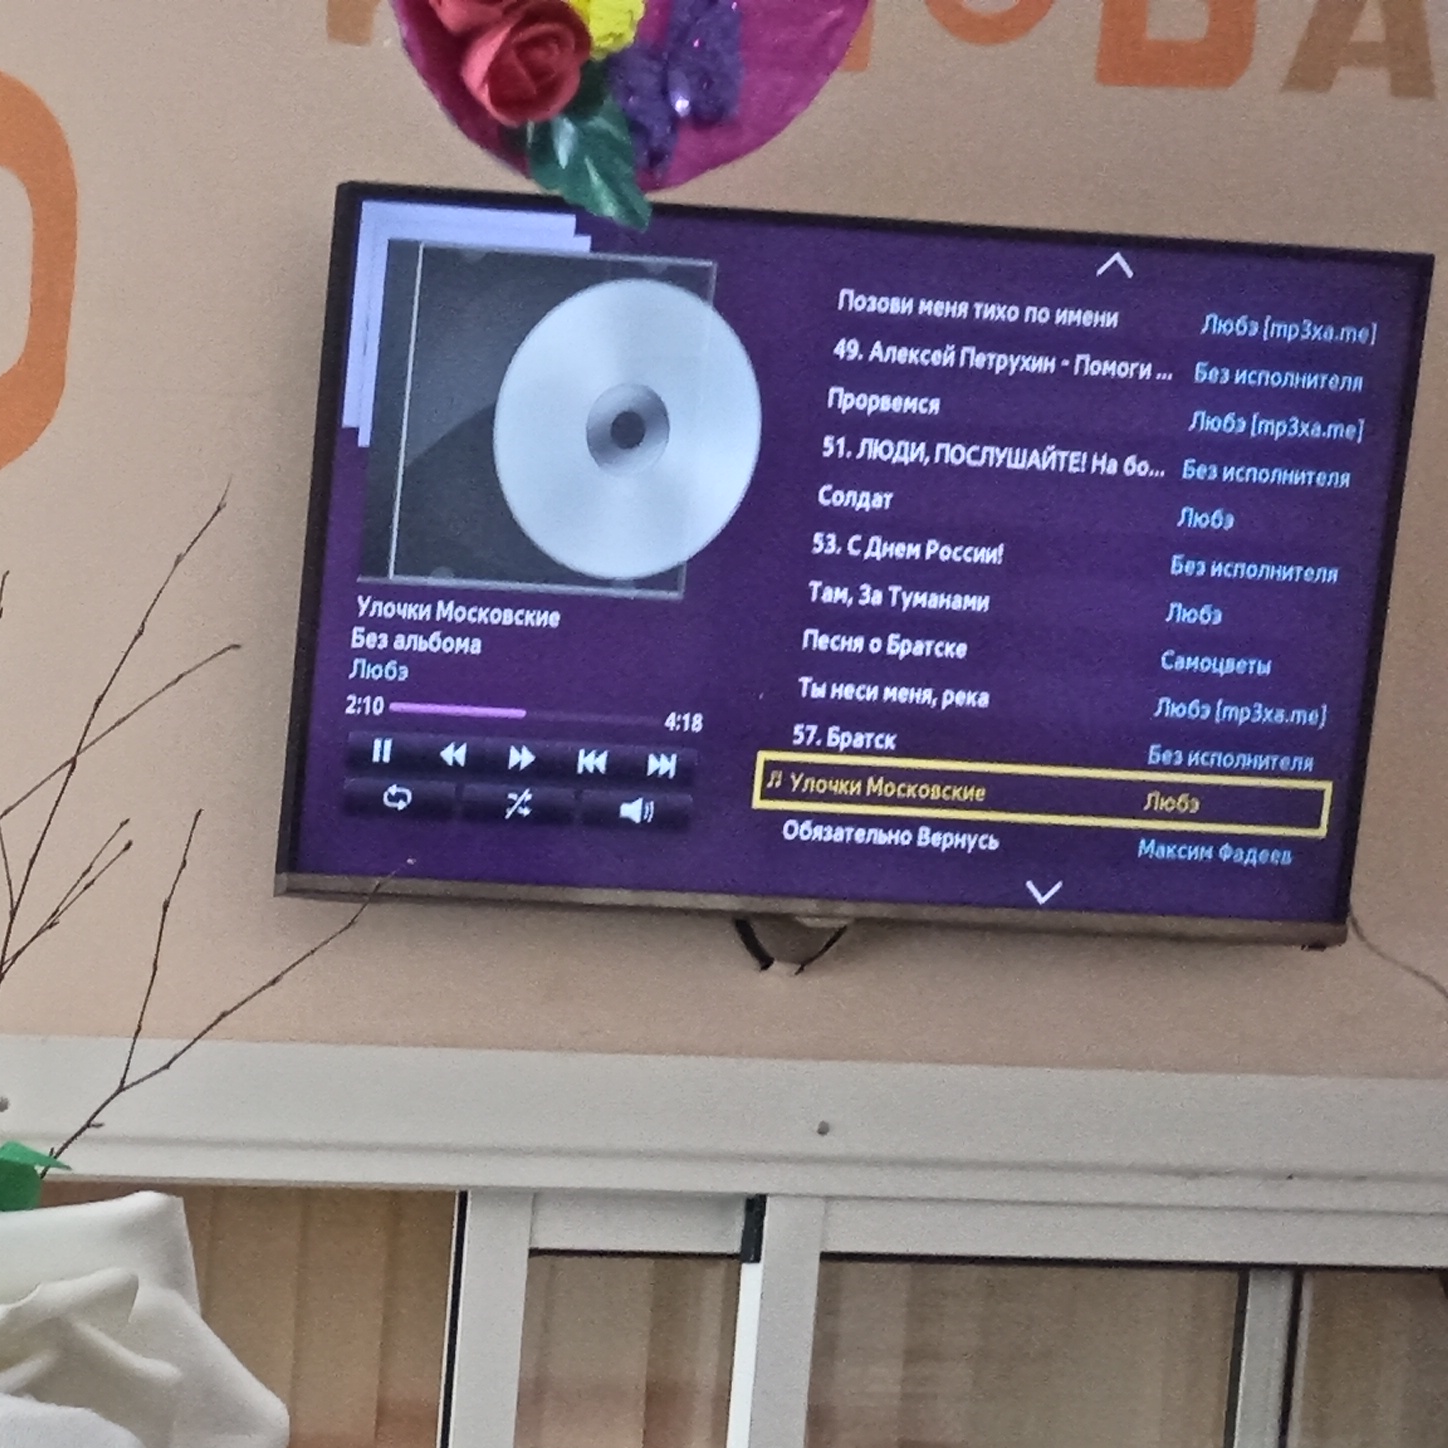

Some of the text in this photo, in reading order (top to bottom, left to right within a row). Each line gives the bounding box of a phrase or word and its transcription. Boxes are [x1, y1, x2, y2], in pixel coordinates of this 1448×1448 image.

[838, 288, 1118, 328] Позови меня тихо по имени
[1200, 313, 1378, 346] Любэ [mp3xa.me]
[833, 338, 863, 361] 49.
[869, 341, 955, 368] Алексей
[960, 347, 1056, 376] Петрухин
[1074, 354, 1152, 380] Помоги
[1194, 361, 1364, 393] Без исполнителя
[827, 386, 940, 416] Прорвемся
[1188, 410, 1365, 444] Любэ [mp3xa.me]
[822, 435, 852, 458] 51.
[856, 437, 930, 466] ЛЮДИ,
[934, 443, 1088, 474] ПОСЛУШАЙТЕ!
[1092, 452, 1117, 476] На
[1182, 458, 1351, 489] Без исполнителя
[818, 485, 893, 511] Солдат
[1177, 506, 1235, 531] Любэ
[812, 532, 1004, 565] 53. С Днем России!
[1170, 554, 1339, 585] Без исполнителя
[356, 595, 561, 629] Улочки Московские
[809, 581, 990, 613] Там, За Туманами
[1165, 601, 1223, 626] Любэ
[351, 626, 482, 655] Без альбома
[802, 629, 968, 660] Песня о Братске
[348, 658, 409, 682] Любэ
[1160, 649, 1272, 677] Самоцветы
[345, 695, 385, 716] 2:10
[799, 676, 990, 711] Ты неси меня, река
[664, 712, 704, 733] 4:18
[1154, 697, 1328, 730] Любэ [mp3xa.me]
[792, 724, 897, 752] 57. Братск
[1147, 744, 1315, 773] Без исполнителя
[790, 771, 986, 802] Улочки Московские
[1143, 790, 1200, 814] Любэ
[783, 819, 1000, 854] Обязательно Вернусь
[1137, 837, 1293, 867] Максим Фадеев
